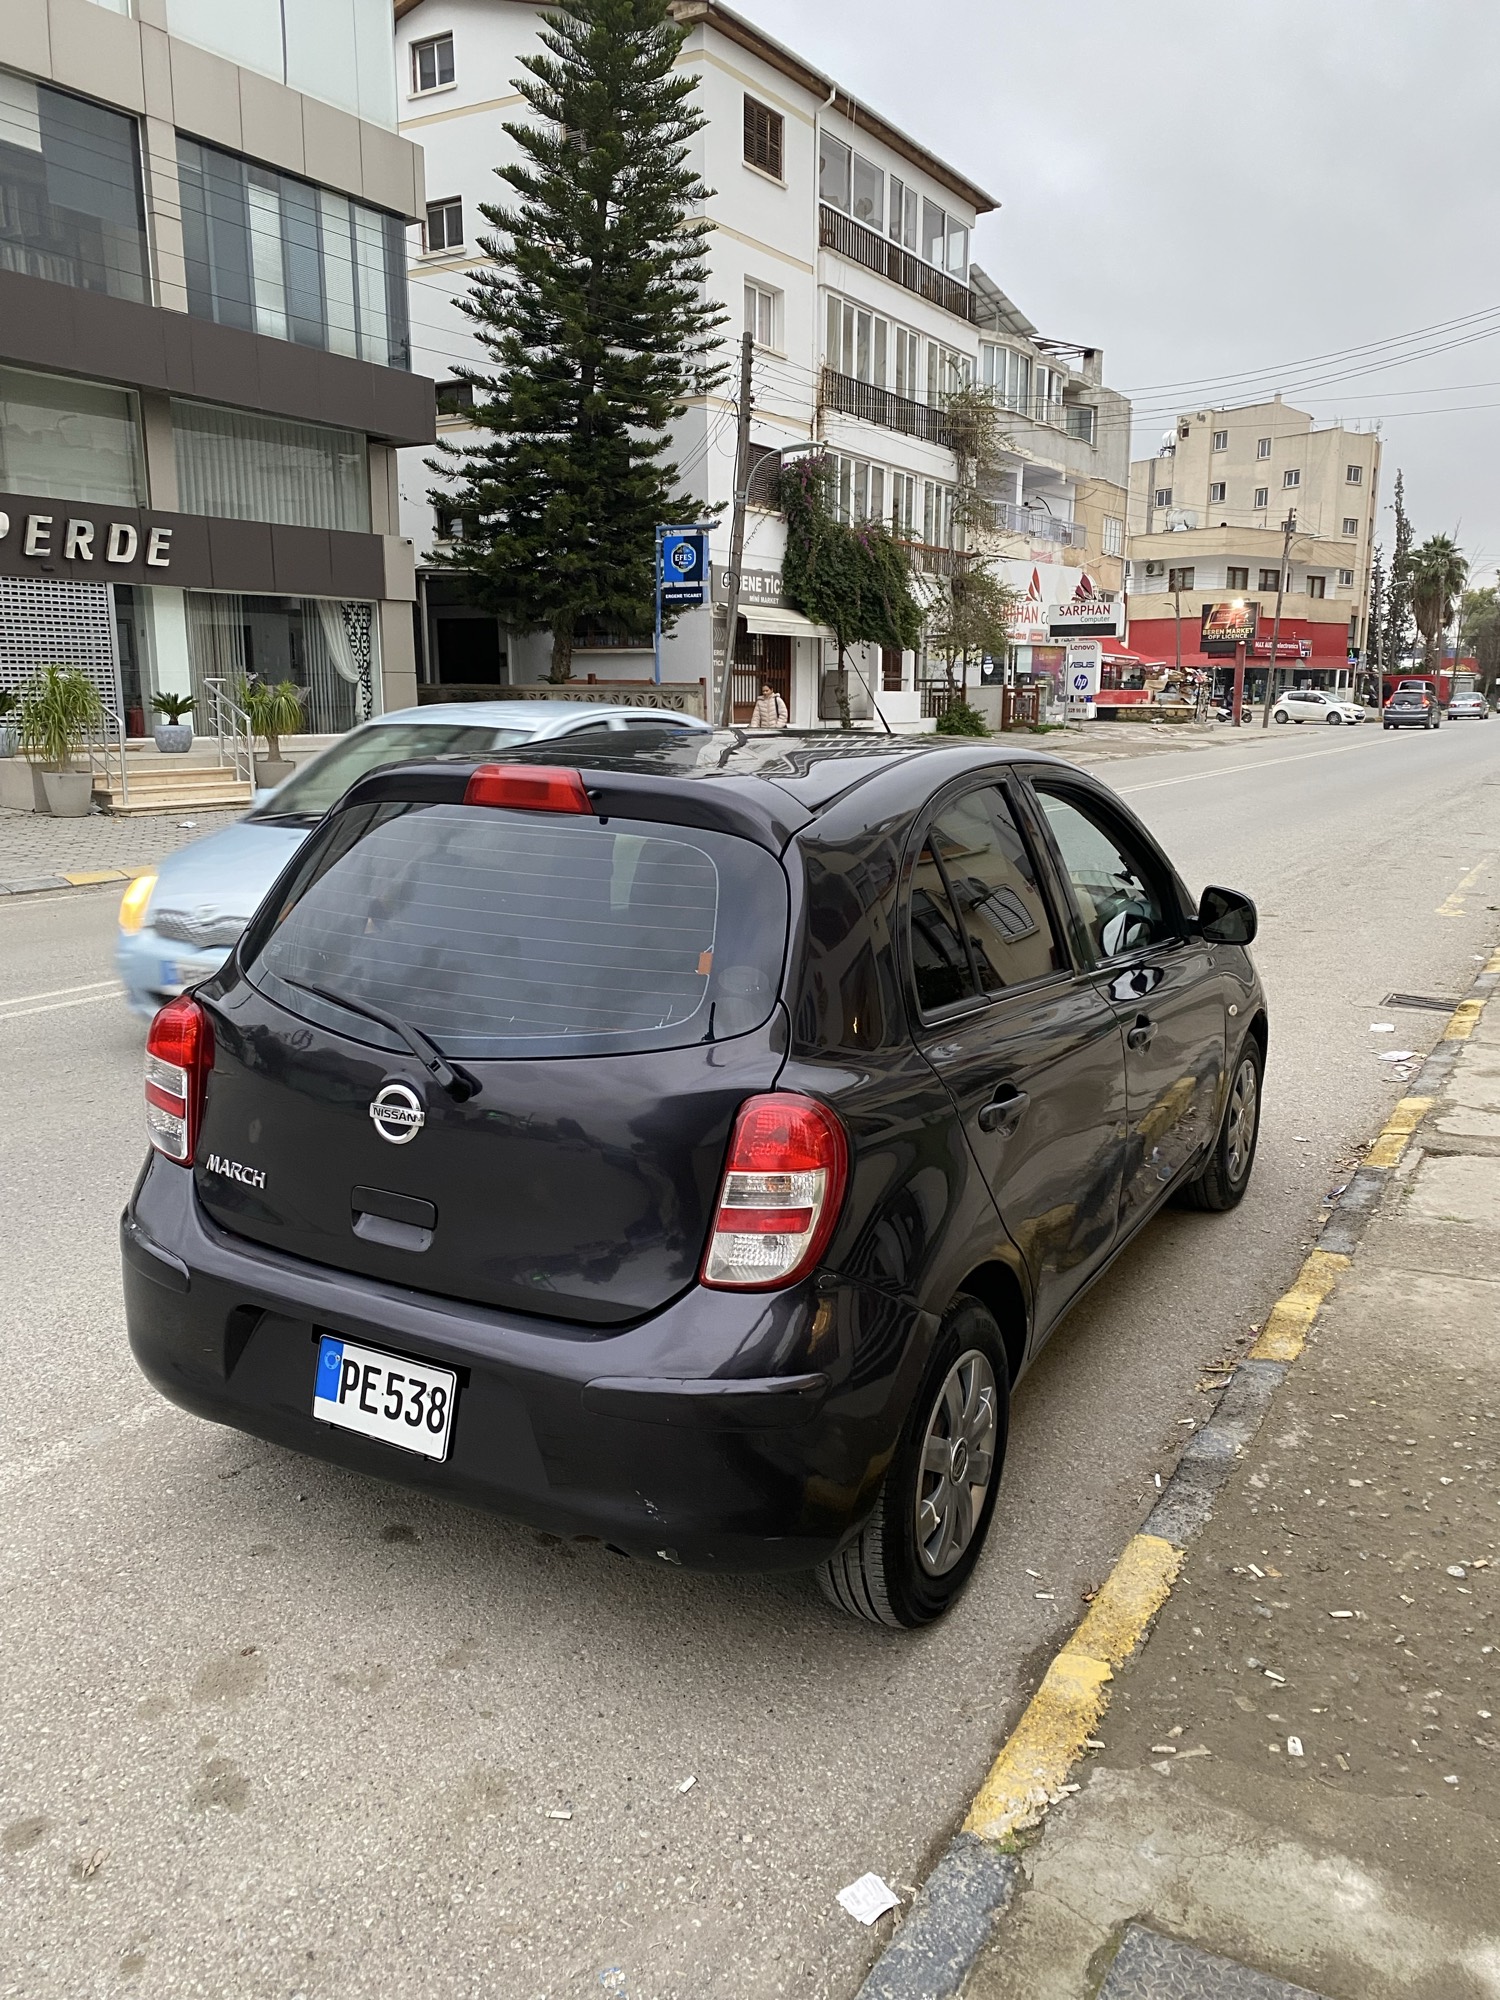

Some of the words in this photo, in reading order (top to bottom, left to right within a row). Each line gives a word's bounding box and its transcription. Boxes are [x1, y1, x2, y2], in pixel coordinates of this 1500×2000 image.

[674, 553, 692, 561] EFES
[721, 572, 762, 593] EENE
[760, 596, 779, 605] MARKET
[1059, 604, 1111, 616] SARPHAN
[1226, 627, 1254, 635] MARKET
[1074, 674, 1088, 691] hp
[373, 1105, 417, 1123] NISSAN
[205, 1153, 267, 1190] MARCH
[338, 1358, 447, 1434] PE538
